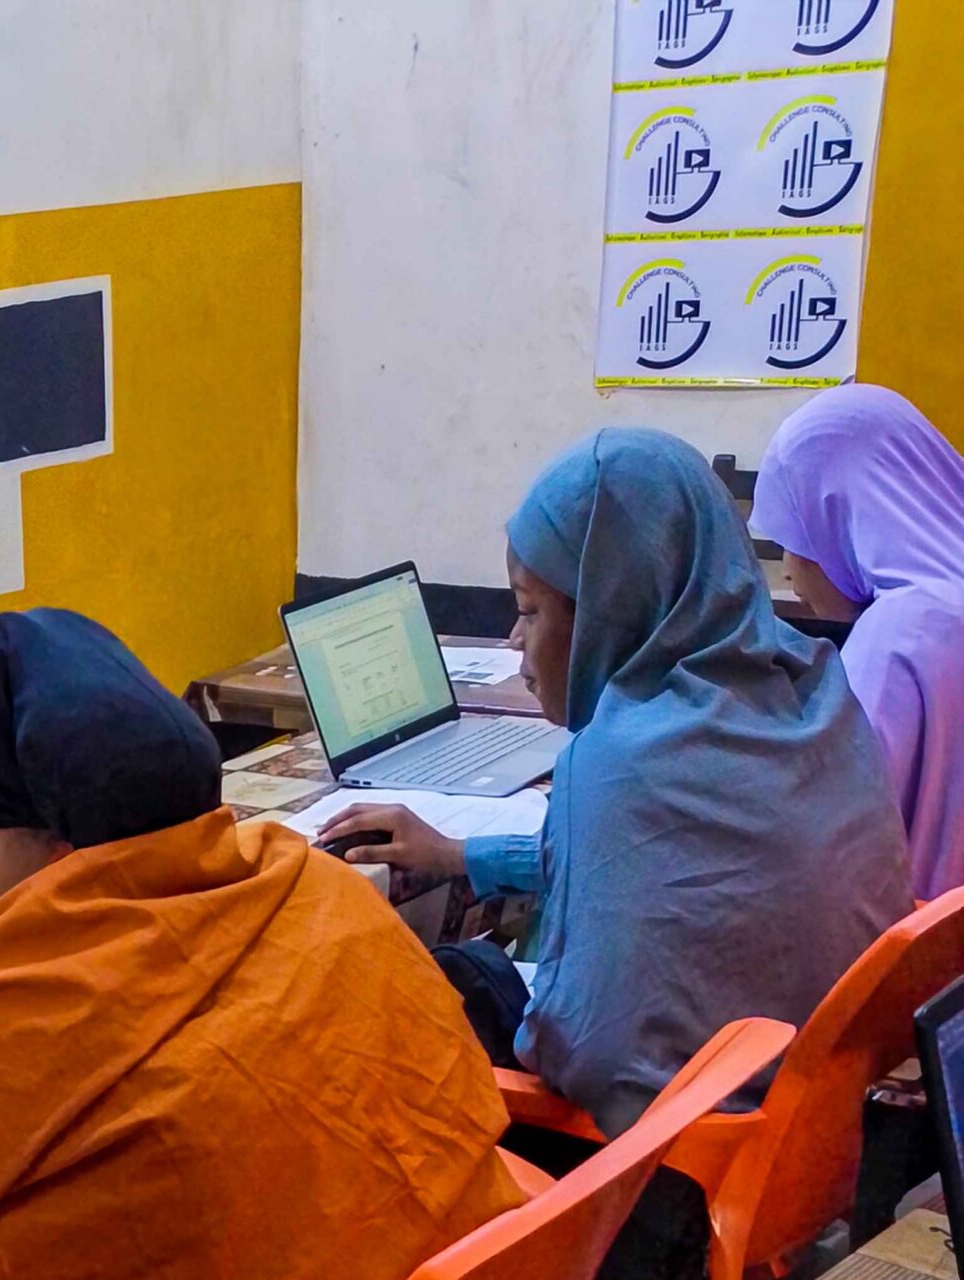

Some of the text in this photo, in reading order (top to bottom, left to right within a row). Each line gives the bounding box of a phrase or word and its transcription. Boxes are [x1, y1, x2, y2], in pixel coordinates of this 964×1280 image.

[635, 115, 710, 151] CHALLENGE CONSULTING
[769, 105, 853, 143] CHALLENGE CONSULTING
[626, 267, 701, 300] CHALLENGE CONSULTING
[756, 263, 837, 298] CHALLENGE CONSULTING
